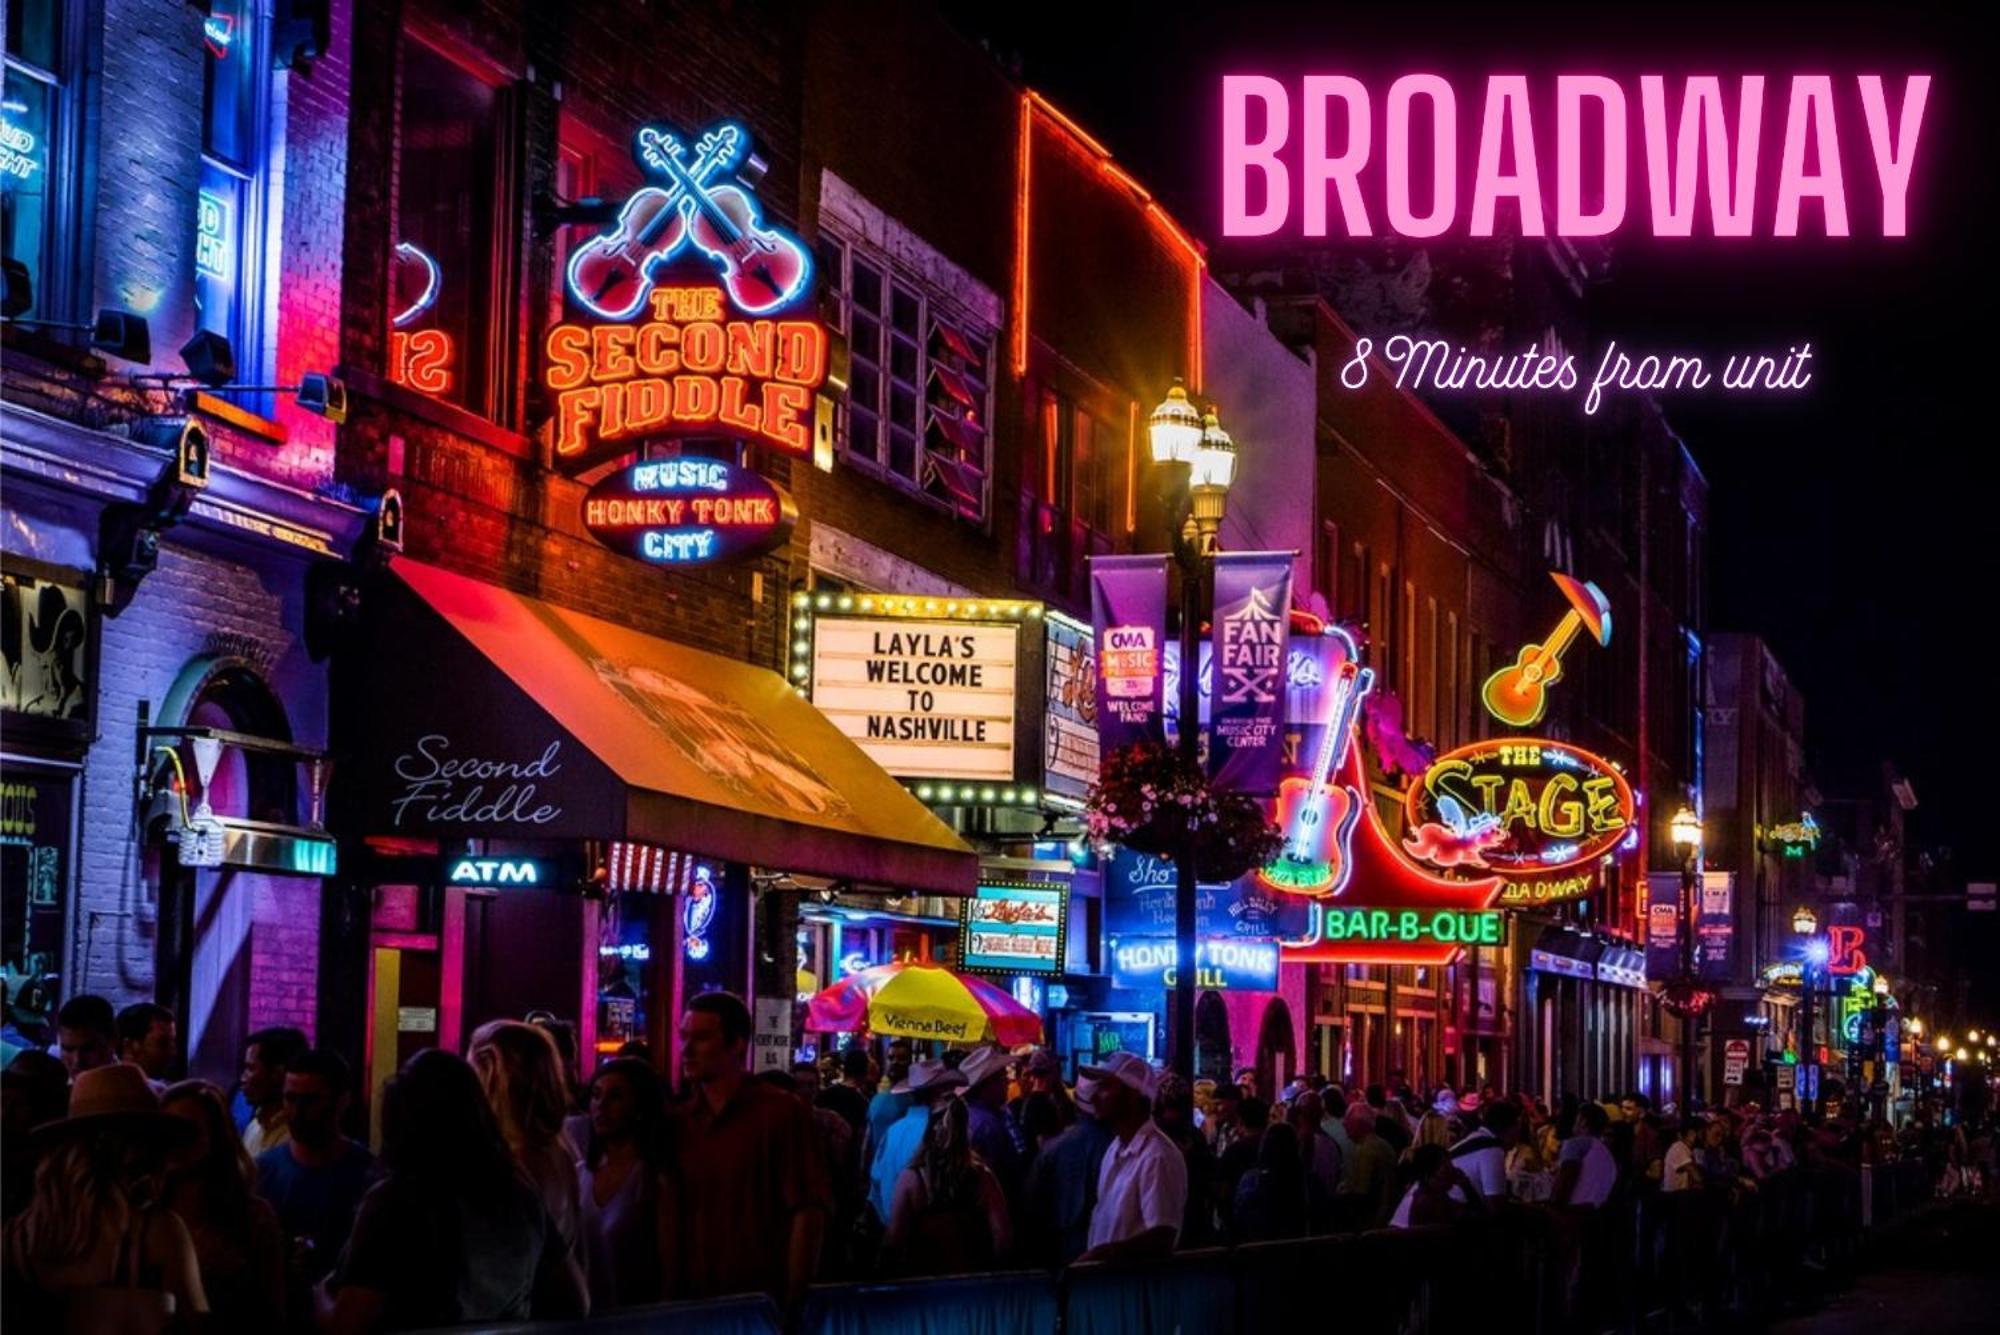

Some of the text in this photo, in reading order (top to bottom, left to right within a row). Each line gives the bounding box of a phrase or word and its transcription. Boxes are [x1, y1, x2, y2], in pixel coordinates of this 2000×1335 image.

[650, 287, 724, 322] THE
[547, 321, 828, 389] SECOND
[557, 376, 813, 456] FIDDLE
[633, 461, 729, 491] MUSIC
[587, 497, 776, 525] HONKY TONK
[643, 530, 714, 560] CITY
[873, 631, 975, 658] LAYLA'S
[1111, 632, 1146, 649] CMA
[1223, 622, 1281, 644] FAN
[1106, 652, 1153, 669] MUSIC
[1223, 645, 1280, 667] FAIR
[866, 660, 983, 687] WELCOME
[908, 690, 934, 712] TO
[1106, 700, 1154, 713] WELCOME
[867, 716, 986, 742] NASHVILLE
[393, 735, 562, 780] Second
[1499, 746, 1541, 766] THE
[392, 780, 562, 826] Fiddle
[1425, 759, 1626, 838] STAGE
[450, 861, 537, 882] ATM
[1326, 910, 1499, 943] BAR-B-QUE
[1207, 943, 1273, 972] TONK
[1164, 967, 1228, 987] GILL
[884, 1013, 968, 1037] Vienna Beef
